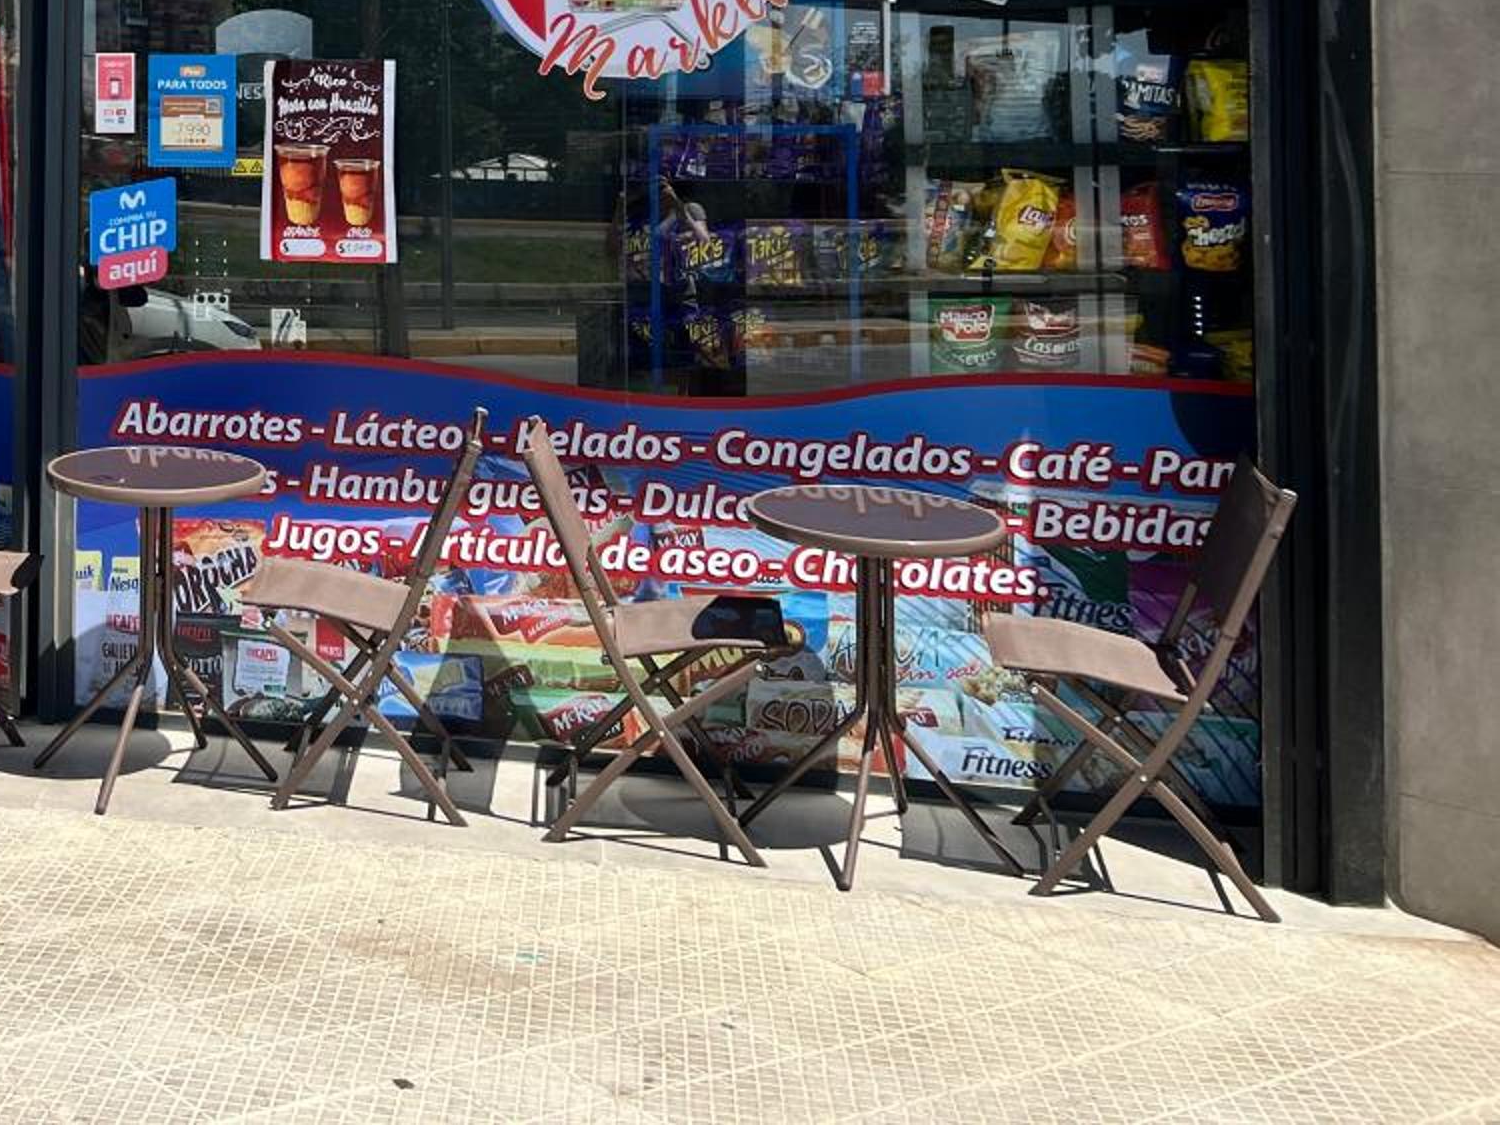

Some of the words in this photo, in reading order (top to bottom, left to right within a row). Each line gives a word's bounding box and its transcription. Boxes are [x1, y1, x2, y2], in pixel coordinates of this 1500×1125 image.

[157, 79, 188, 90] PARA
[191, 79, 228, 90] TODOS
[99, 218, 168, 254] CHIP
[108, 250, 157, 284] aquí
[939, 310, 988, 322] Marco
[117, 402, 303, 443] Abarrotes
[333, 412, 464, 451] Lácteo
[716, 429, 973, 476] Congelados
[1008, 441, 1113, 483] Café
[308, 464, 608, 517] Hambugueas
[642, 482, 751, 522] Dulce
[269, 516, 381, 560] Jugos
[410, 524, 567, 566] rtículo
[601, 534, 650, 572] de
[658, 547, 759, 579] aseo
[794, 548, 1051, 597] Choolates.
[110, 576, 139, 594] Nesq
[961, 745, 1053, 779] Fitness
